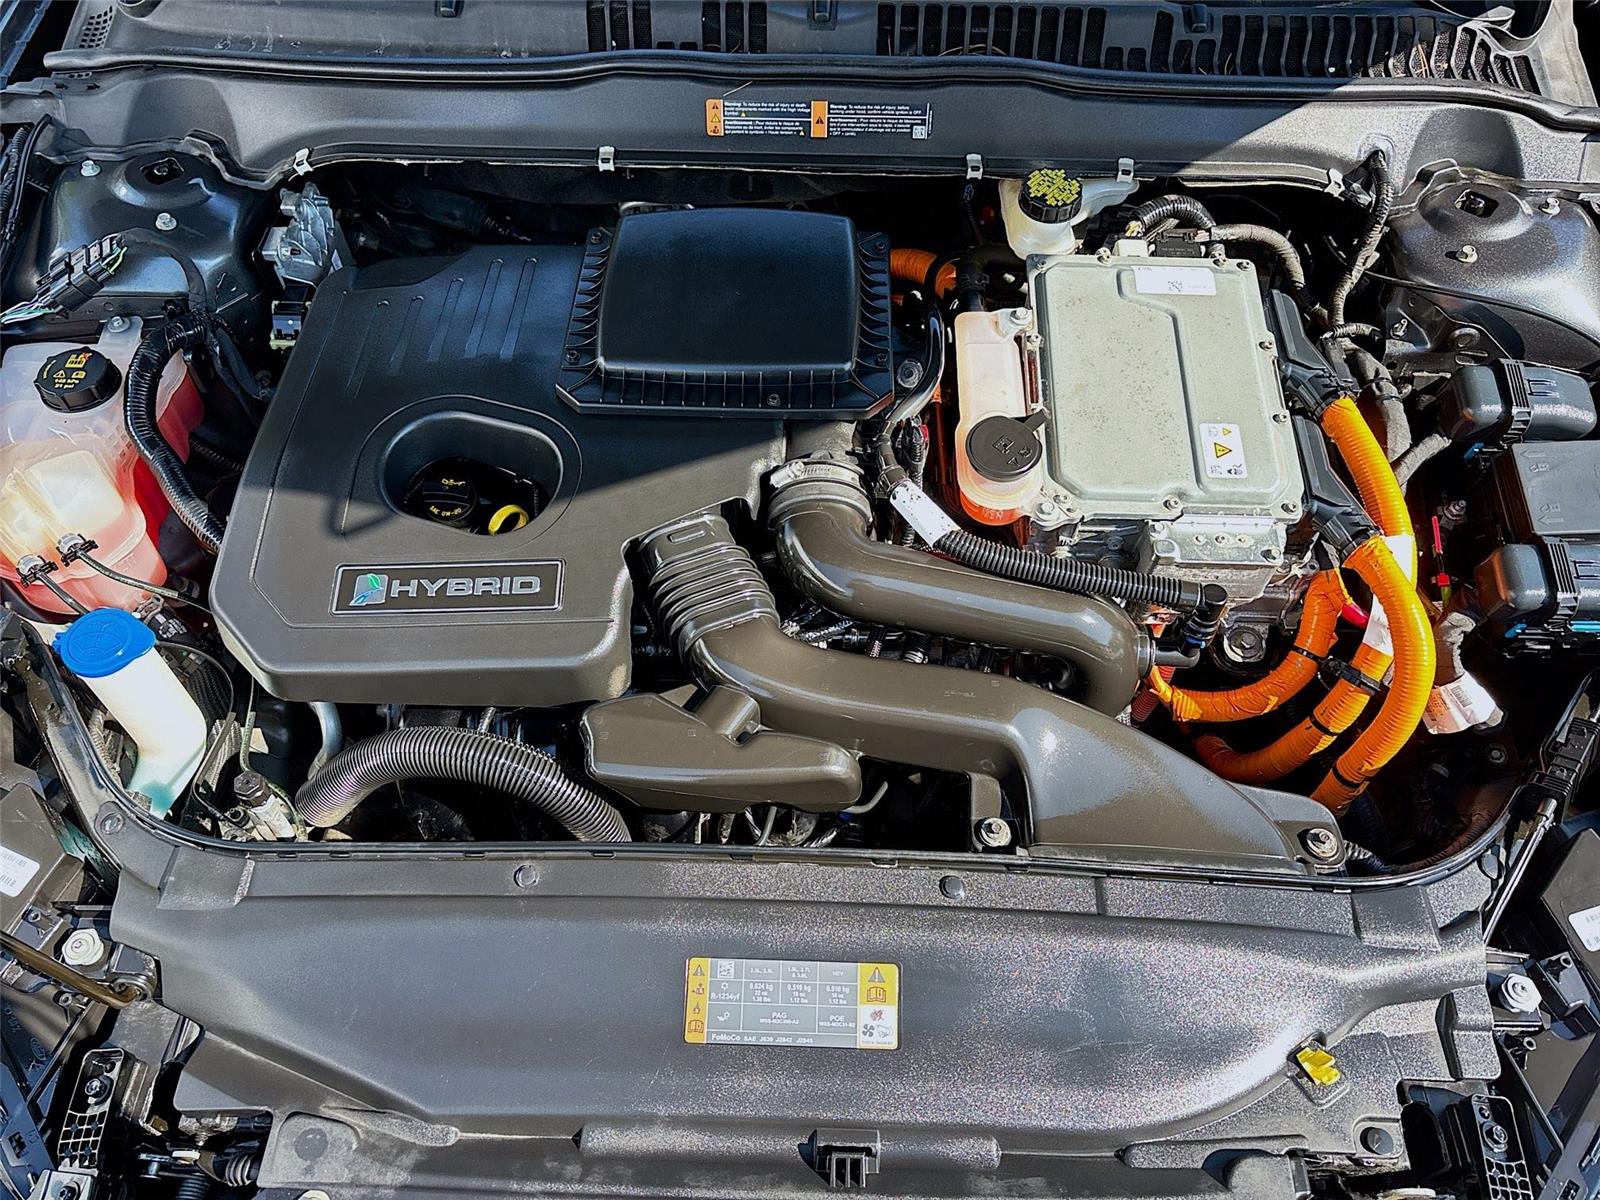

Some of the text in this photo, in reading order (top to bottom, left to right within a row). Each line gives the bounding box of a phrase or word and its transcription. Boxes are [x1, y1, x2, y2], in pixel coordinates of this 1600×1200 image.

[390, 576, 540, 597] HYBRID
[765, 983, 773, 991] kg
[803, 984, 811, 992] kg
[842, 986, 850, 994] kg
[710, 992, 740, 1001] R-1234yf
